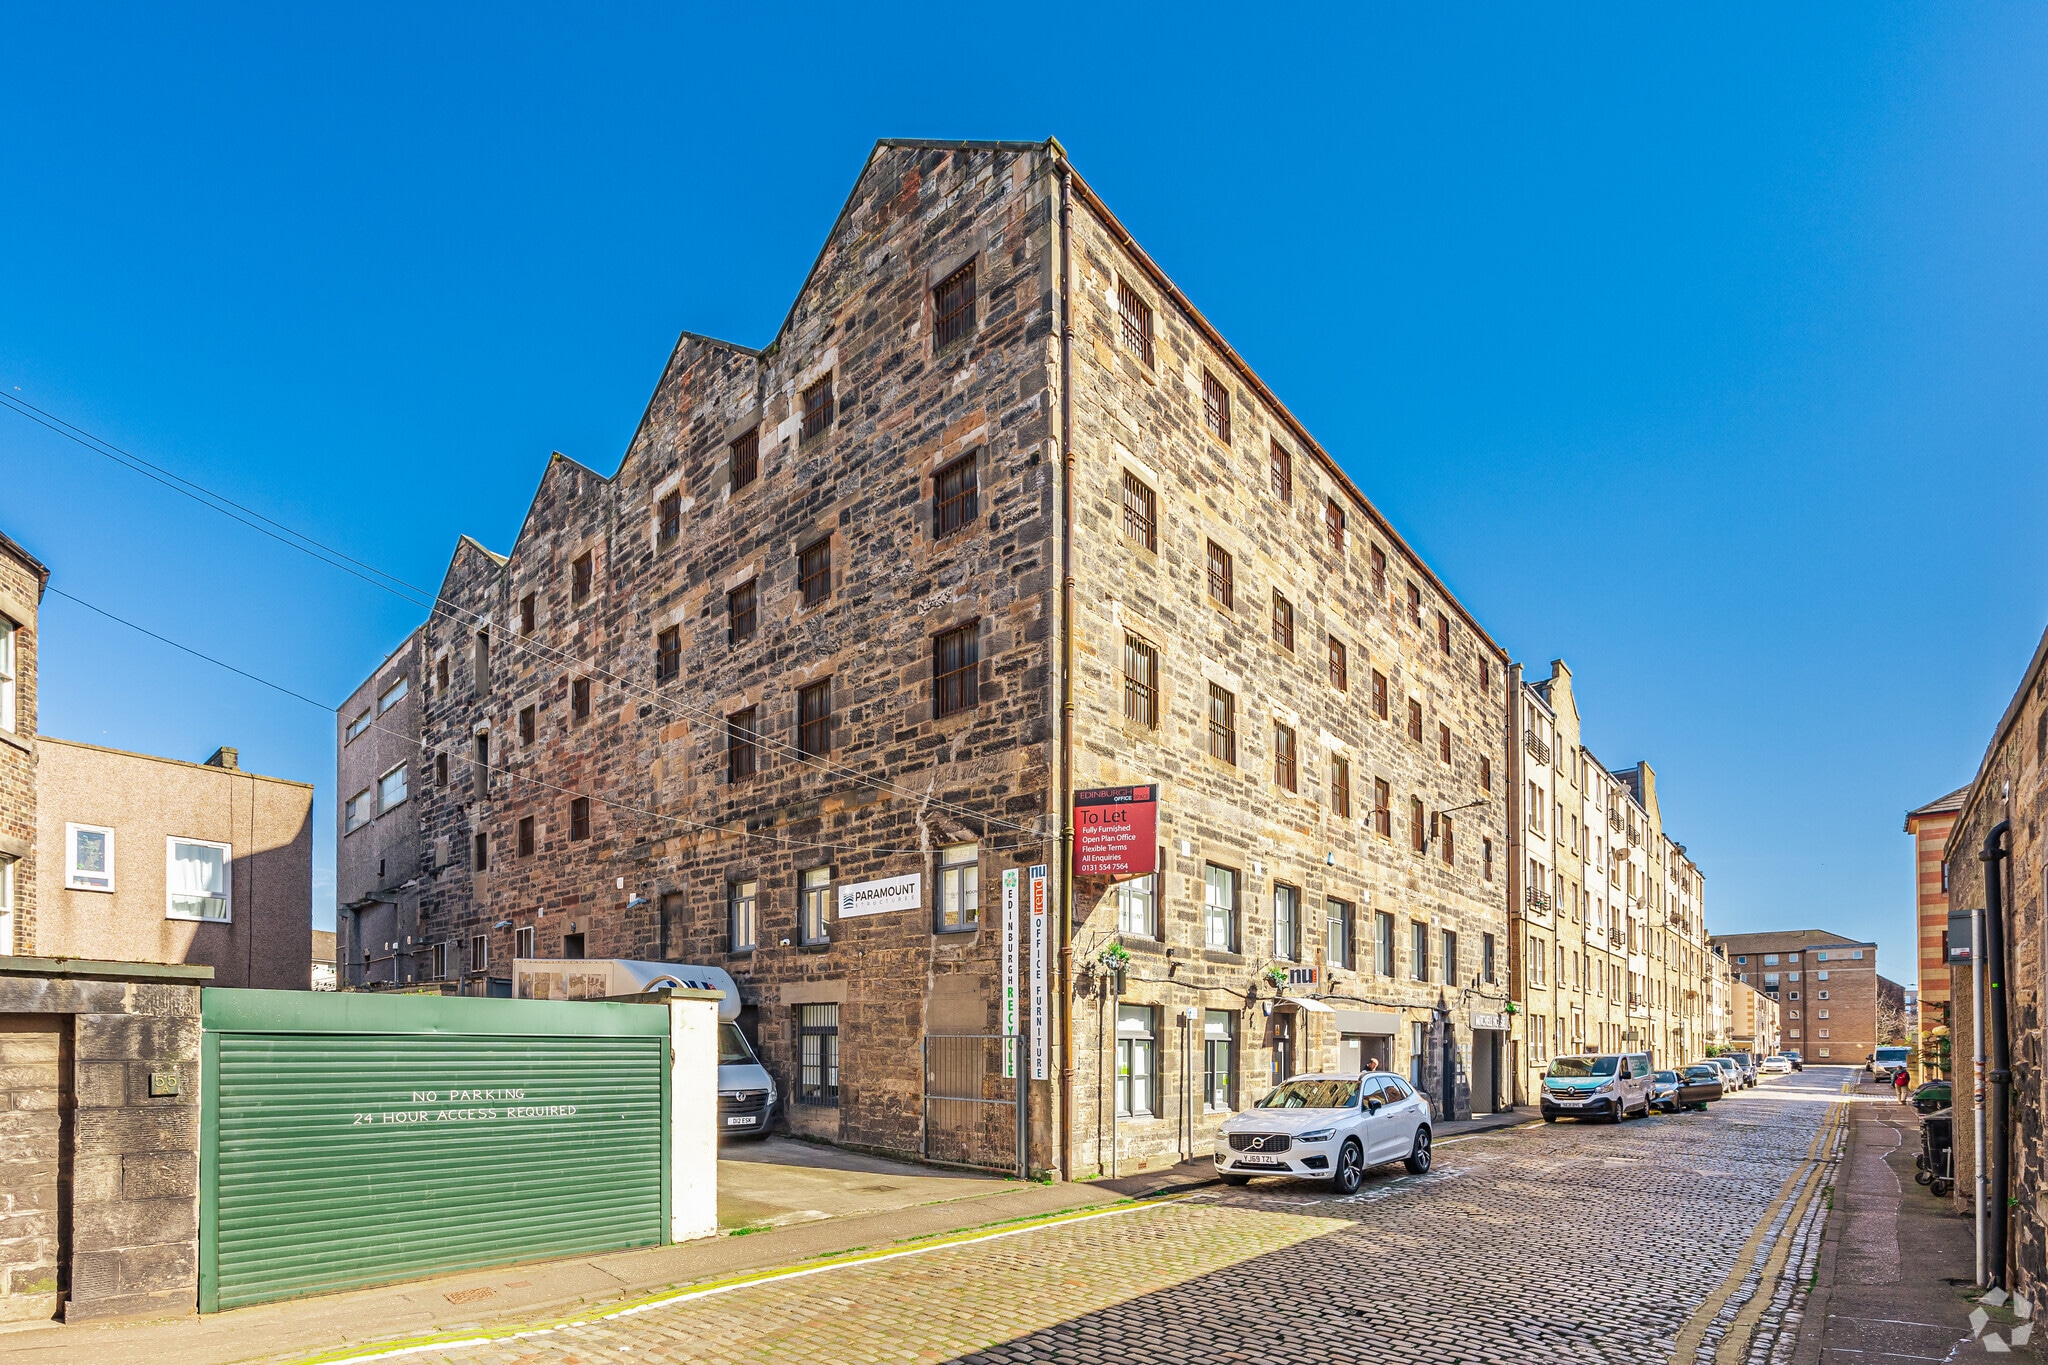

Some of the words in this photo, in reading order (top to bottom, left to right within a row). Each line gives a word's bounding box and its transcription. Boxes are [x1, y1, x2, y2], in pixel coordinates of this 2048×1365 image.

[1080, 788, 1132, 800] EDINBURGH
[1081, 809, 1098, 825] To
[1103, 809, 1127, 823] Let
[1082, 826, 1097, 835] Fully
[1098, 824, 1131, 833] Furnished
[1082, 836, 1100, 844] Open
[1101, 834, 1116, 842] Plan
[1116, 833, 1136, 842] Office
[1082, 844, 1107, 853] Flexible
[1092, 854, 1122, 863] Enquiries
[1031, 865, 1046, 879] nu
[1081, 864, 1097, 872] 0131
[1099, 863, 1111, 871] 554
[1112, 862, 1129, 870] 7564
[855, 882, 915, 902] PARAMOUNT
[855, 894, 915, 908] STRUCTURES
[1289, 968, 1312, 984] nu
[155, 1074, 177, 1087] 55
[412, 1090, 437, 1102] NO
[449, 1088, 525, 1101] PARKING
[353, 1113, 373, 1125] 24
[383, 1111, 428, 1124] HOUR
[437, 1107, 497, 1121] ACCESS
[507, 1105, 577, 1119] REQUIRED
[1243, 1154, 1260, 1163] YJ69
[1261, 1155, 1275, 1164] TZL
